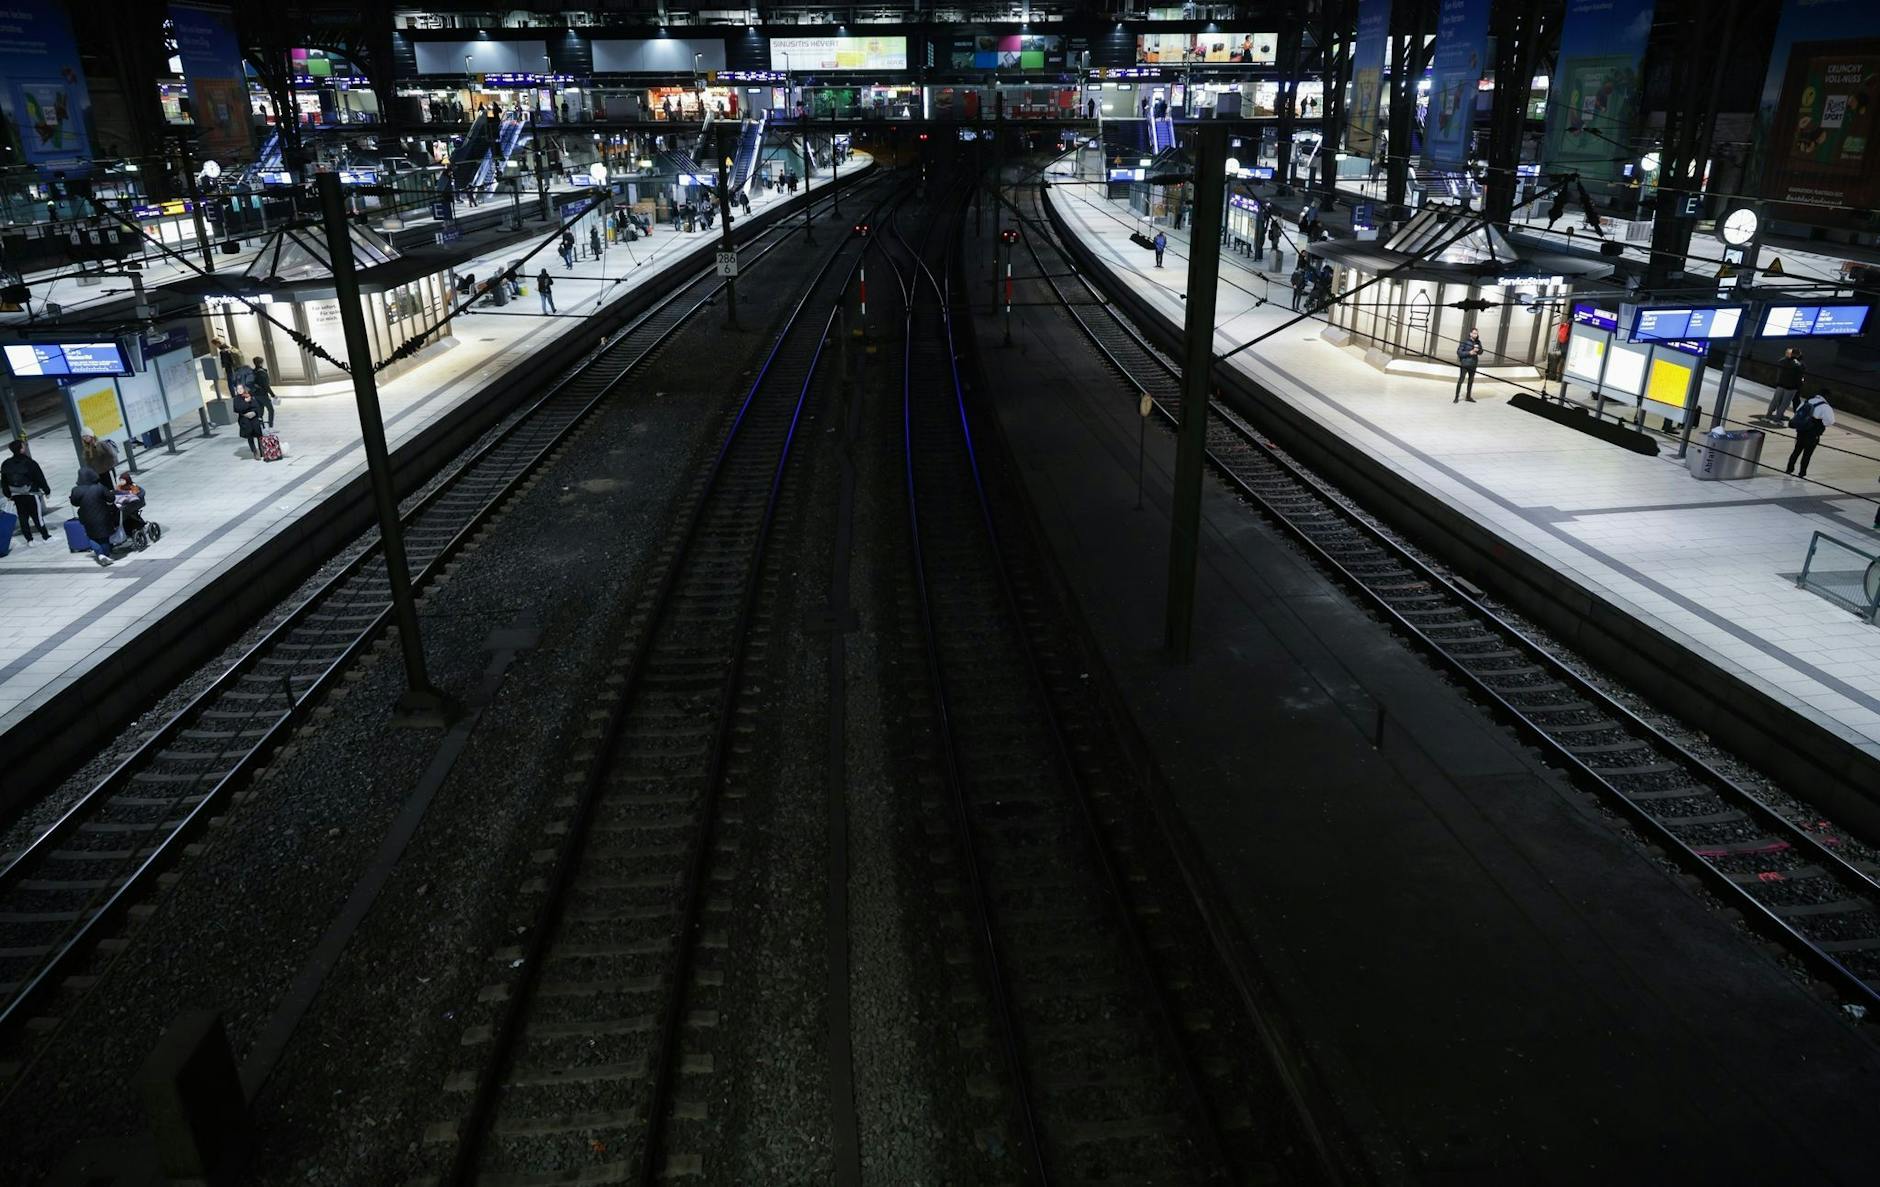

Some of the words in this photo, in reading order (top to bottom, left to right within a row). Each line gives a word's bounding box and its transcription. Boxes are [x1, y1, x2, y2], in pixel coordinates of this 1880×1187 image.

[205, 205, 217, 220] E
[433, 203, 445, 218] E
[1355, 205, 1365, 221] E
[1685, 197, 1698, 214] E
[718, 253, 736, 263] 286
[724, 264, 731, 273] 6
[1498, 276, 1550, 286] ServiceStore
[1704, 448, 1715, 473] Abfal
